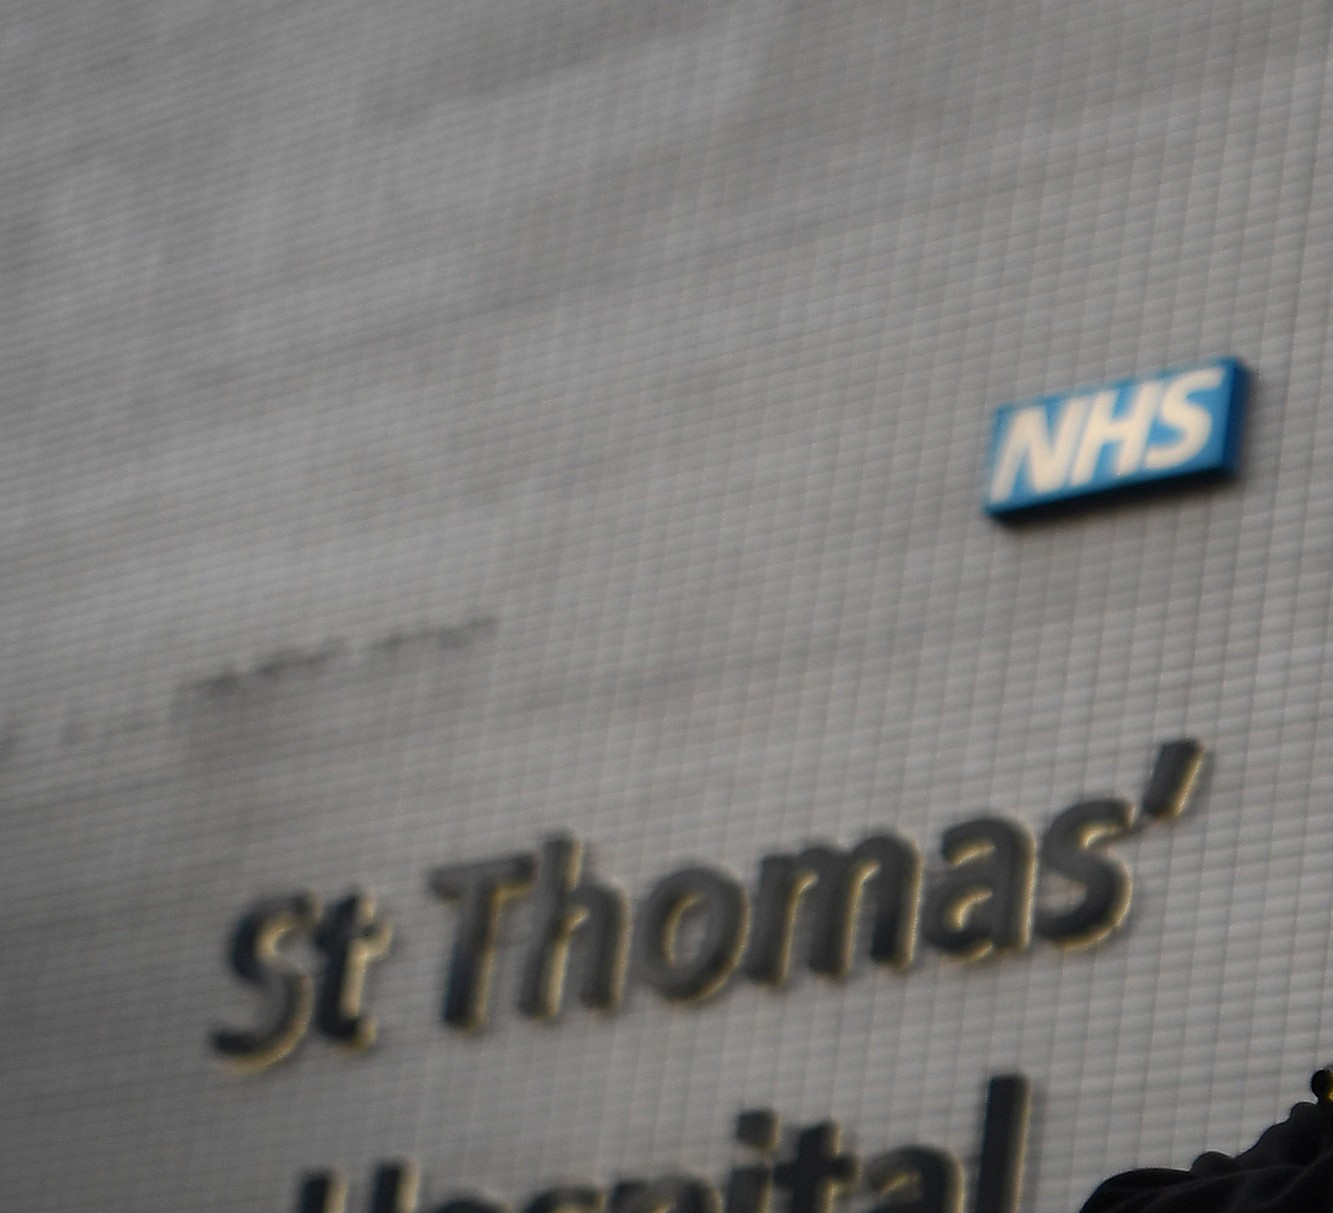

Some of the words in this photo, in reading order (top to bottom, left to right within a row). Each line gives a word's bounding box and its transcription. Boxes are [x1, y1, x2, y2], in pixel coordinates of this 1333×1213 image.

[989, 366, 1225, 504] NHS
[212, 888, 392, 1074] St
[428, 738, 1204, 1034] Thomas'
